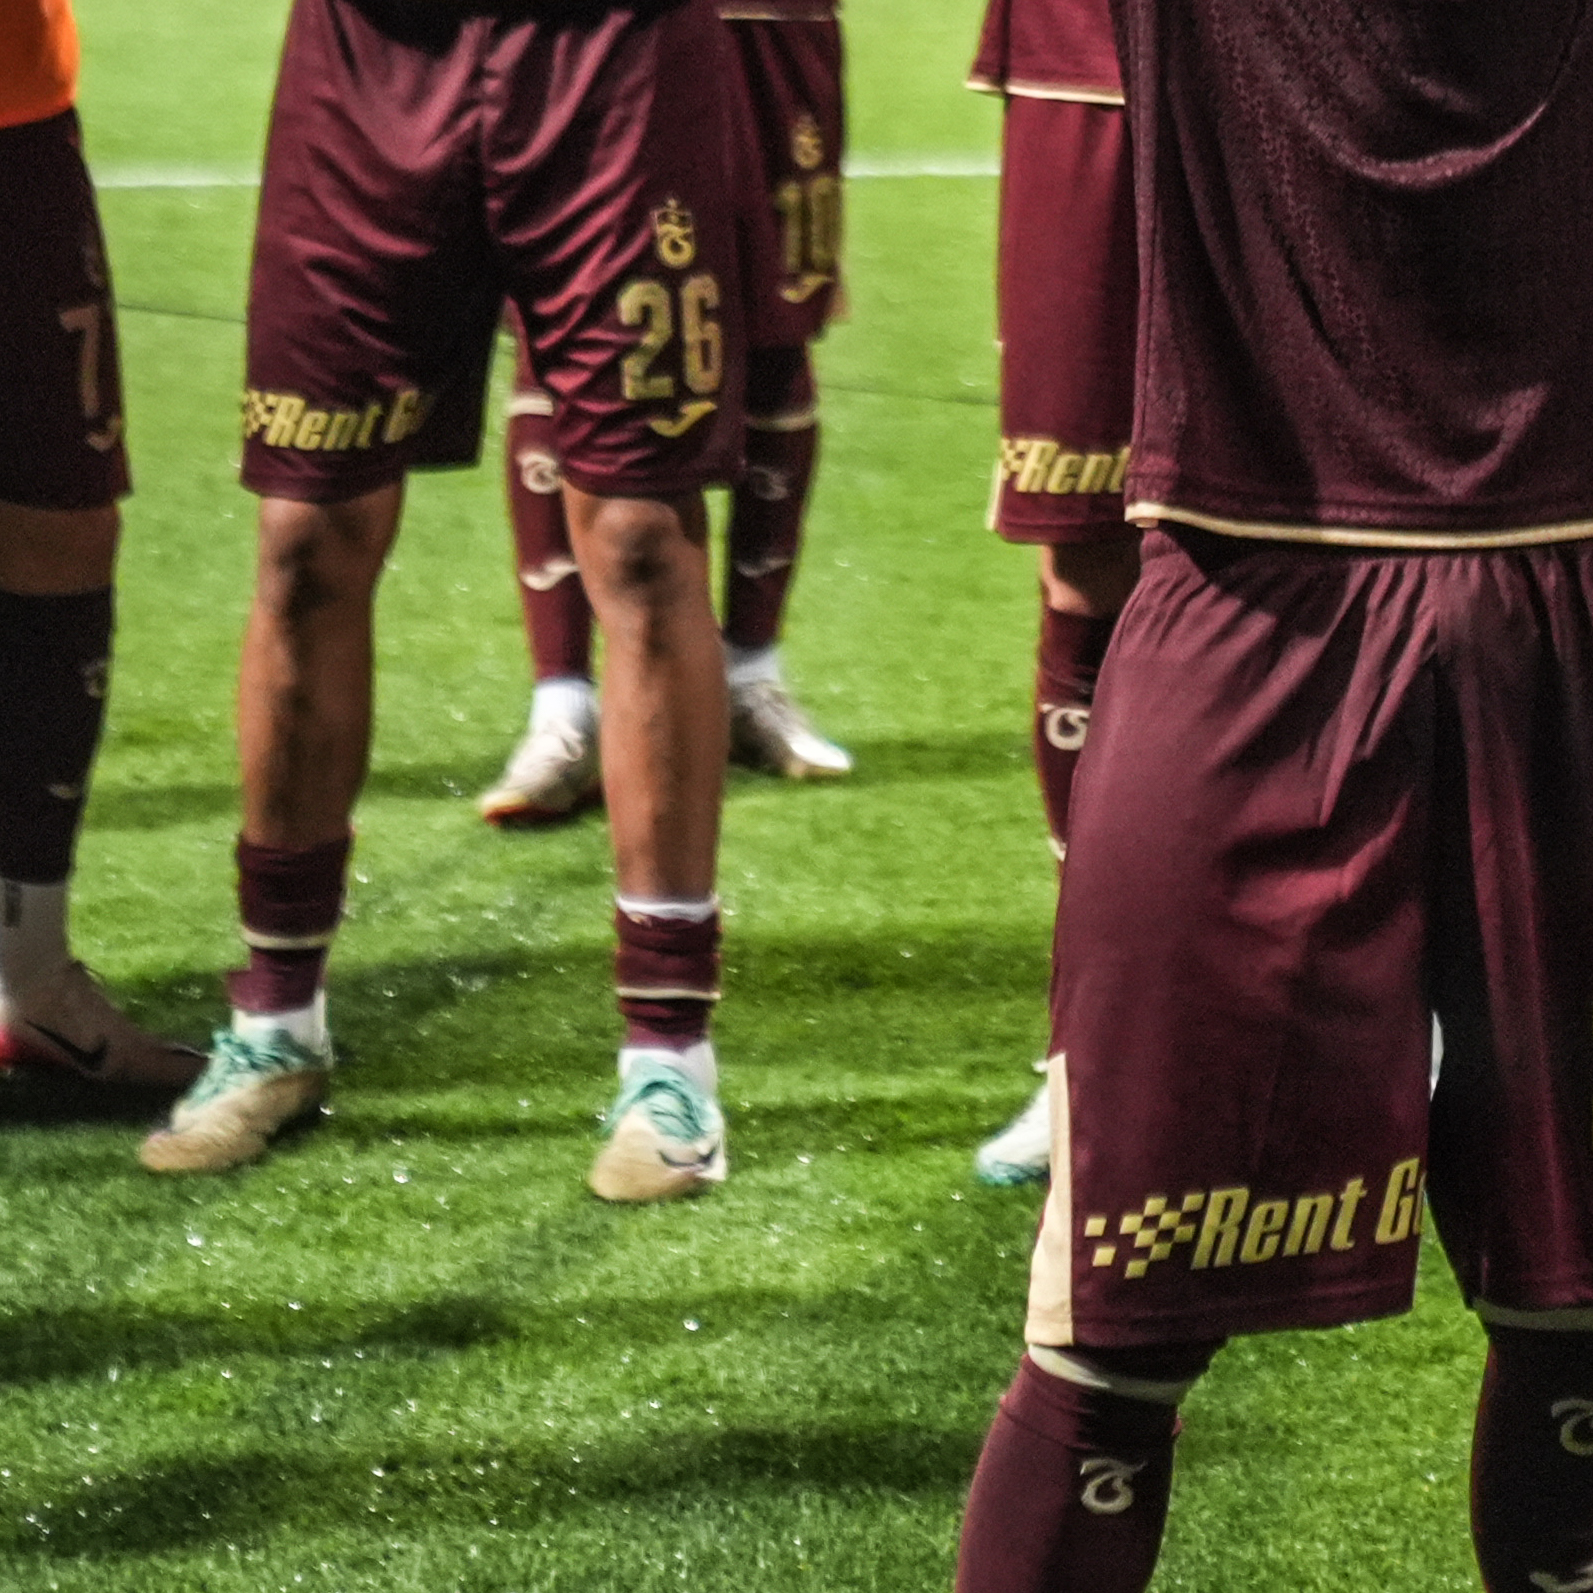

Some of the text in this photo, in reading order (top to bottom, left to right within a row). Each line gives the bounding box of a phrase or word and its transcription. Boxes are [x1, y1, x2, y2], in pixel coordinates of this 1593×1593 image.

[618, 273, 722, 400] 26
[263, 393, 383, 452] Rent
[1190, 1156, 1427, 1270] Rent G
